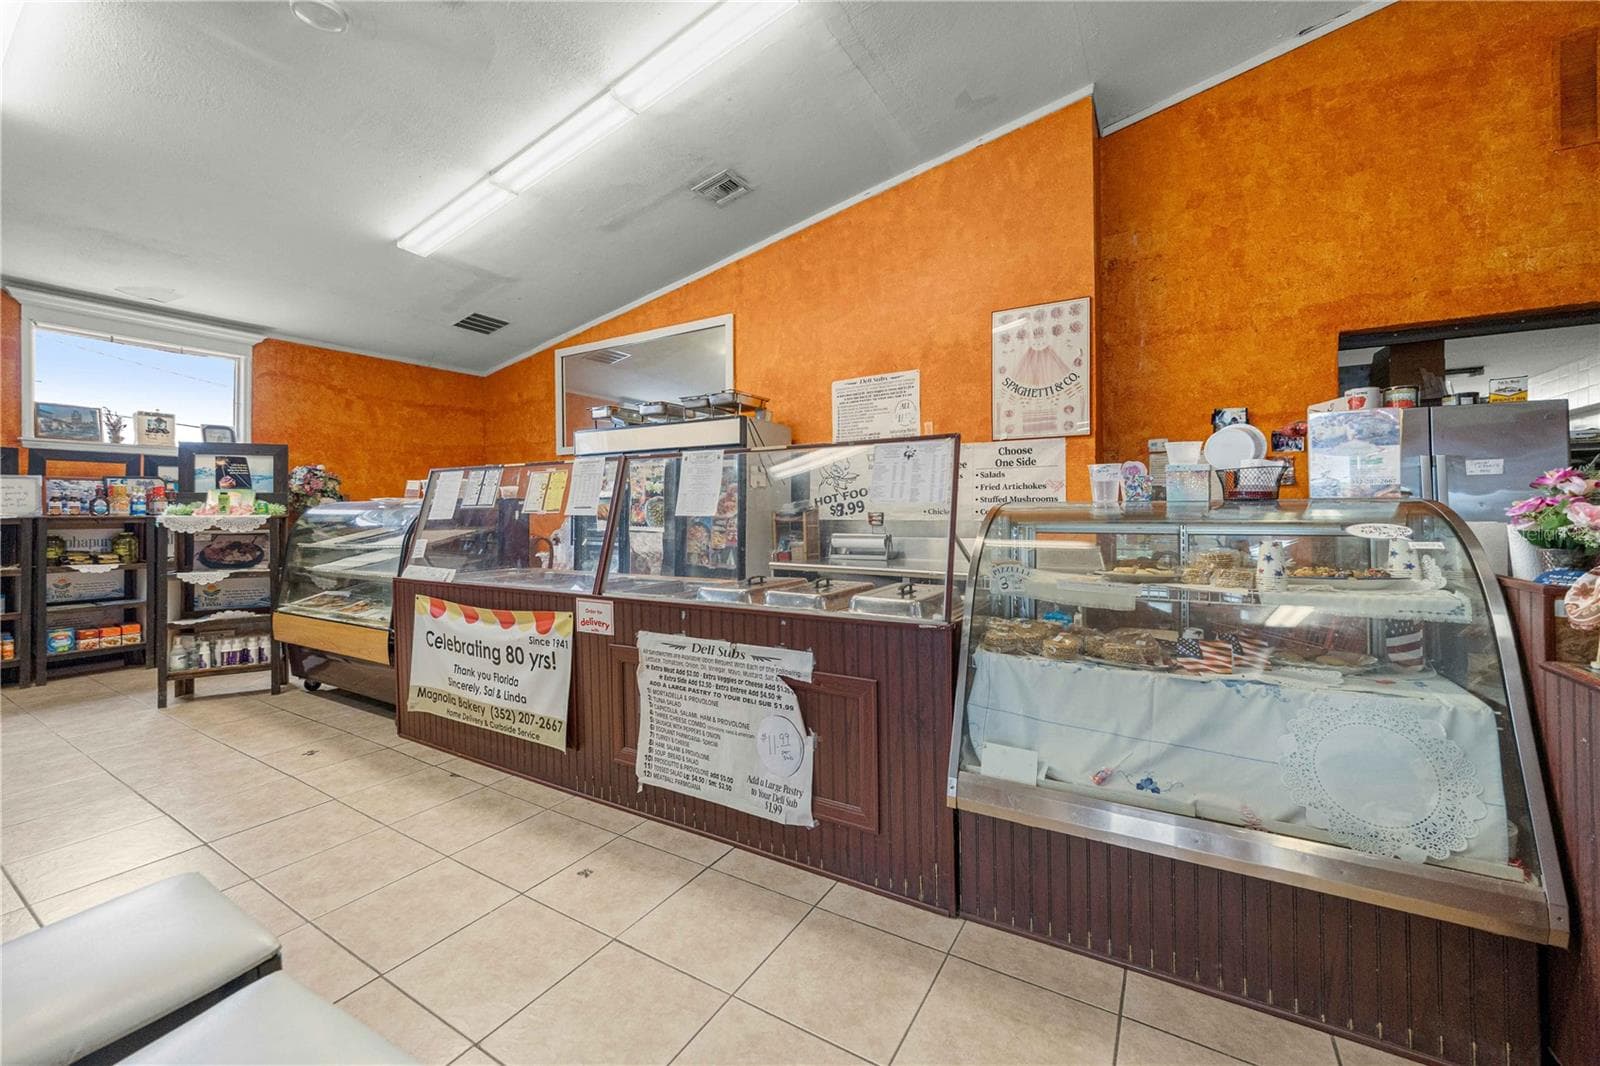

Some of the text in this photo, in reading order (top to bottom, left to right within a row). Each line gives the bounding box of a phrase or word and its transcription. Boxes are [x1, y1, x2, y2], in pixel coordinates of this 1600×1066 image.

[1002, 373, 1080, 397] SPAGHETTI & CO.
[998, 447, 1033, 456] Choose
[995, 457, 1037, 467] One Side
[814, 487, 869, 506] HOT FOO
[580, 617, 610, 630] delivery
[425, 630, 557, 671] Celebrating 80 yrs!
[528, 636, 569, 649] Since 1941
[692, 643, 746, 660] Deli Subs
[453, 664, 519, 687] Thank you Florida
[651, 664, 663, 672] Extra
[676, 668, 685, 676] Add
[703, 673, 716, 681] Extra
[717, 675, 736, 685] Veggies
[745, 680, 763, 689] Cheese
[764, 683, 775, 691] Add
[447, 677, 527, 704] Sincerely, Sal & Linda
[677, 677, 687, 685] Side
[715, 683, 729, 692] Extra
[730, 686, 747, 695] Entree
[748, 689, 759, 697] Add
[666, 699, 682, 708] SALAD
[668, 684, 686, 692] LARGE
[688, 687, 712, 696] PASTRY
[723, 694, 741, 702] YOUR
[743, 697, 757, 706] DELI
[758, 700, 772, 708] SUB
[773, 703, 794, 711] $1.99
[417, 687, 563, 733] Magnolia Bakery (352) 207-2667
[446, 708, 541, 741] Home Delivery & Curbside Service
[717, 717, 751, 731] PROVOLONE
[746, 775, 804, 797] Add a Large Pastry
[751, 788, 798, 808] to Your Deli Sub
[765, 802, 783, 815] $1.99
